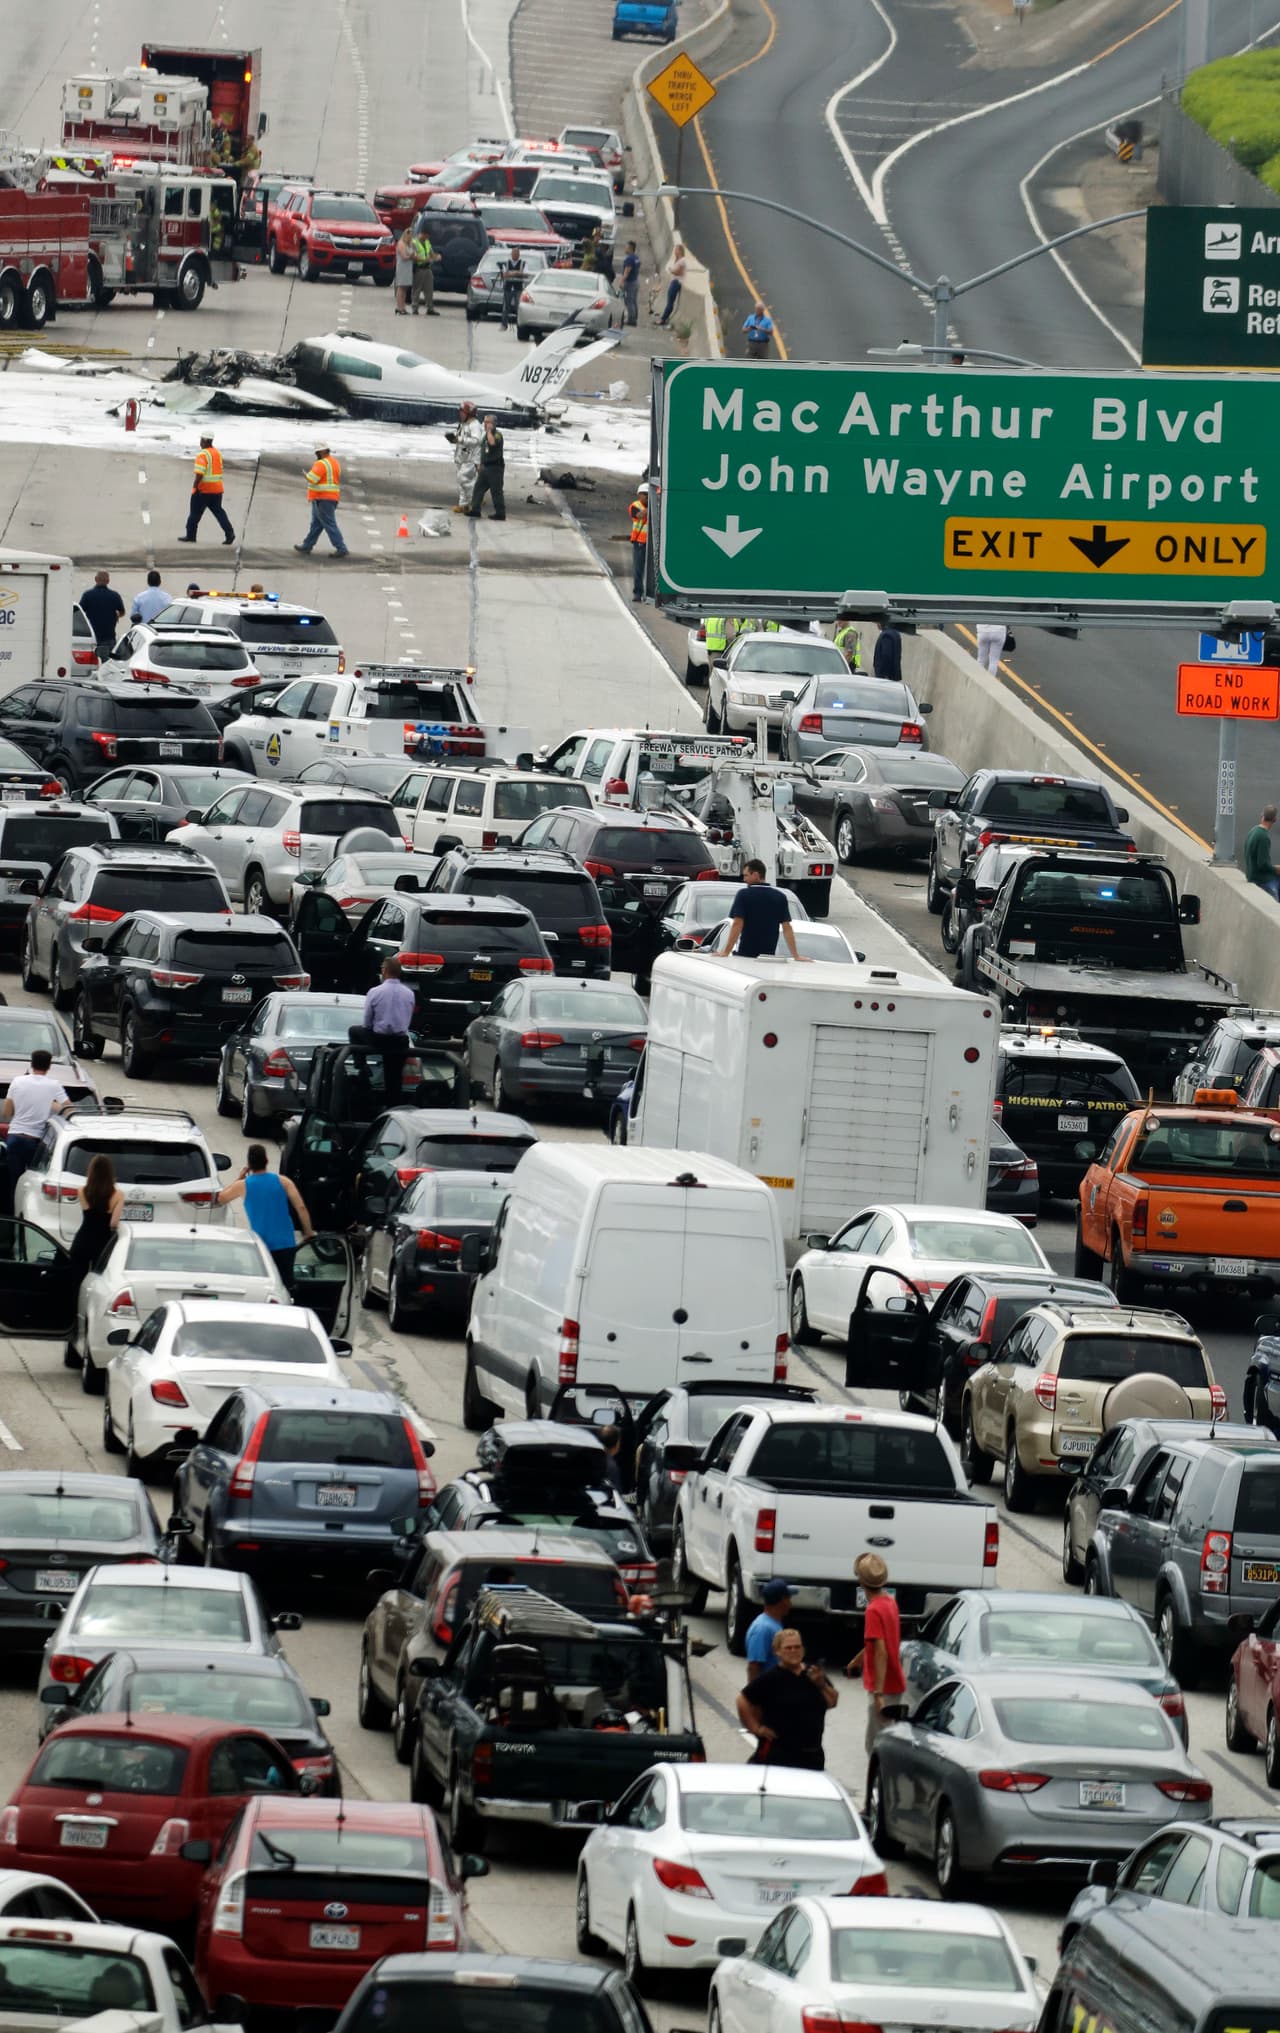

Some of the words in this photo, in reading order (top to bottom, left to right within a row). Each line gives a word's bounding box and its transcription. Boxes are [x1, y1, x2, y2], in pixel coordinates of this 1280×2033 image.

[520, 365, 569, 385] N8729
[702, 387, 820, 433] Mac
[838, 391, 1054, 439] Arthur
[1092, 397, 1224, 443] Blvd
[701, 453, 829, 493] John
[863, 457, 1027, 505] Wayne
[1059, 463, 1259, 510] Airport
[952, 530, 1042, 559] EXIT
[1155, 535, 1257, 565] ONLY
[1215, 673, 1244, 689] END
[1186, 693, 1223, 709] ROAD
[1231, 695, 1271, 711] WORK
[640, 742, 677, 754] FREEWAY
[680, 745, 715, 755] SERVICE
[716, 747, 743, 757] PATRO
[1008, 1095, 1063, 1108] HIGHWAY
[1087, 1101, 1129, 1112] PATROL
